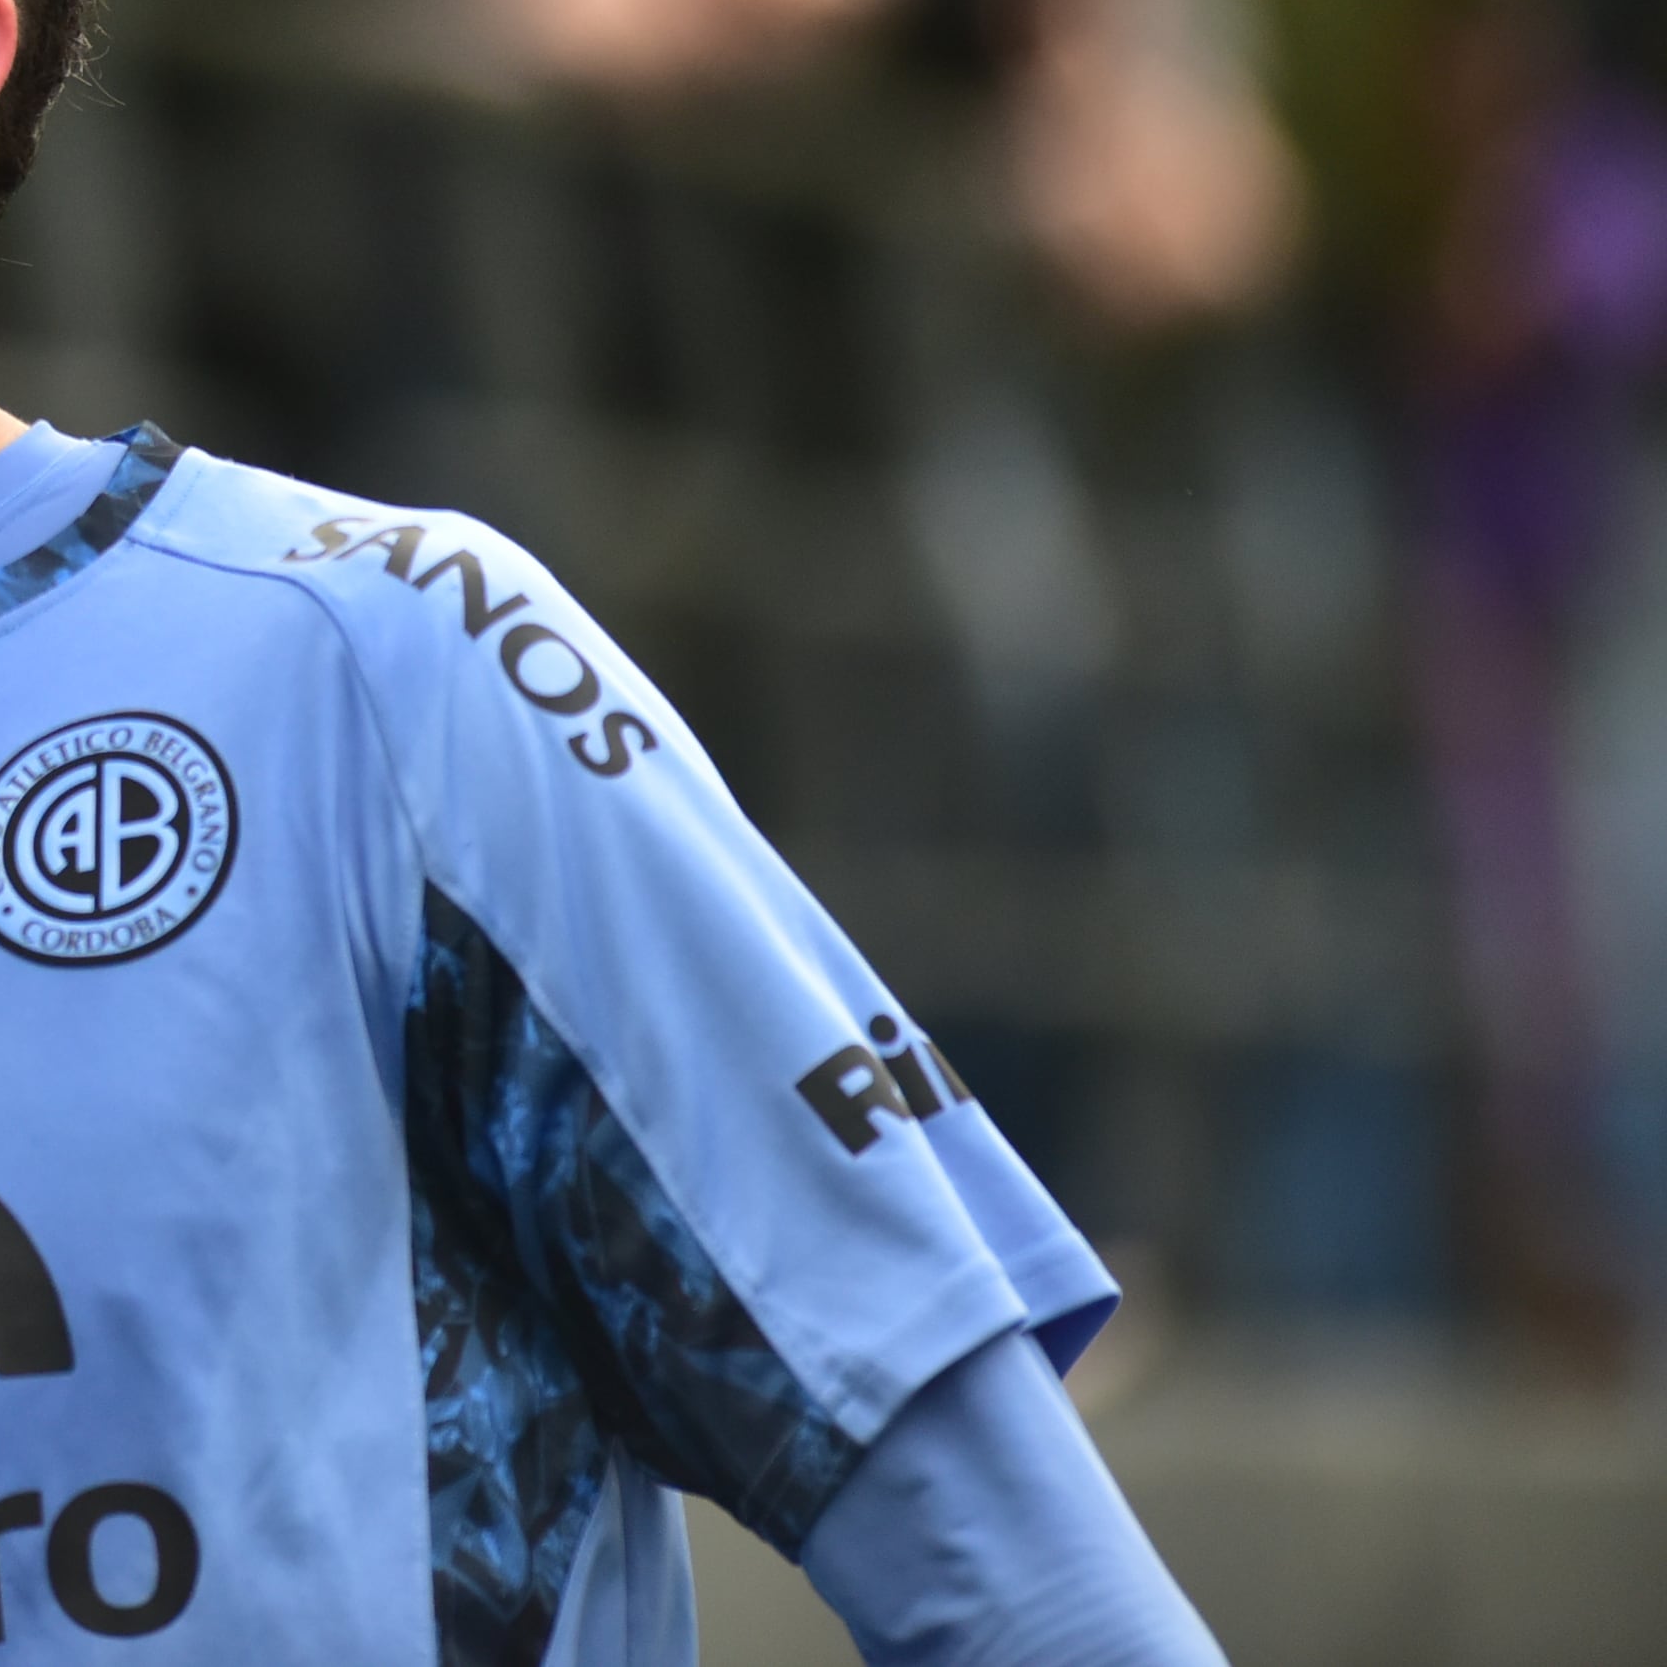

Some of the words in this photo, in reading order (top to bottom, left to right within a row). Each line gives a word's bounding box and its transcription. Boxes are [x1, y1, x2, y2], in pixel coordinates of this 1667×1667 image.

[281, 518, 659, 779] SANOS
[143, 729, 223, 874] BELGRANO
[21, 905, 178, 953] CORDOBA
